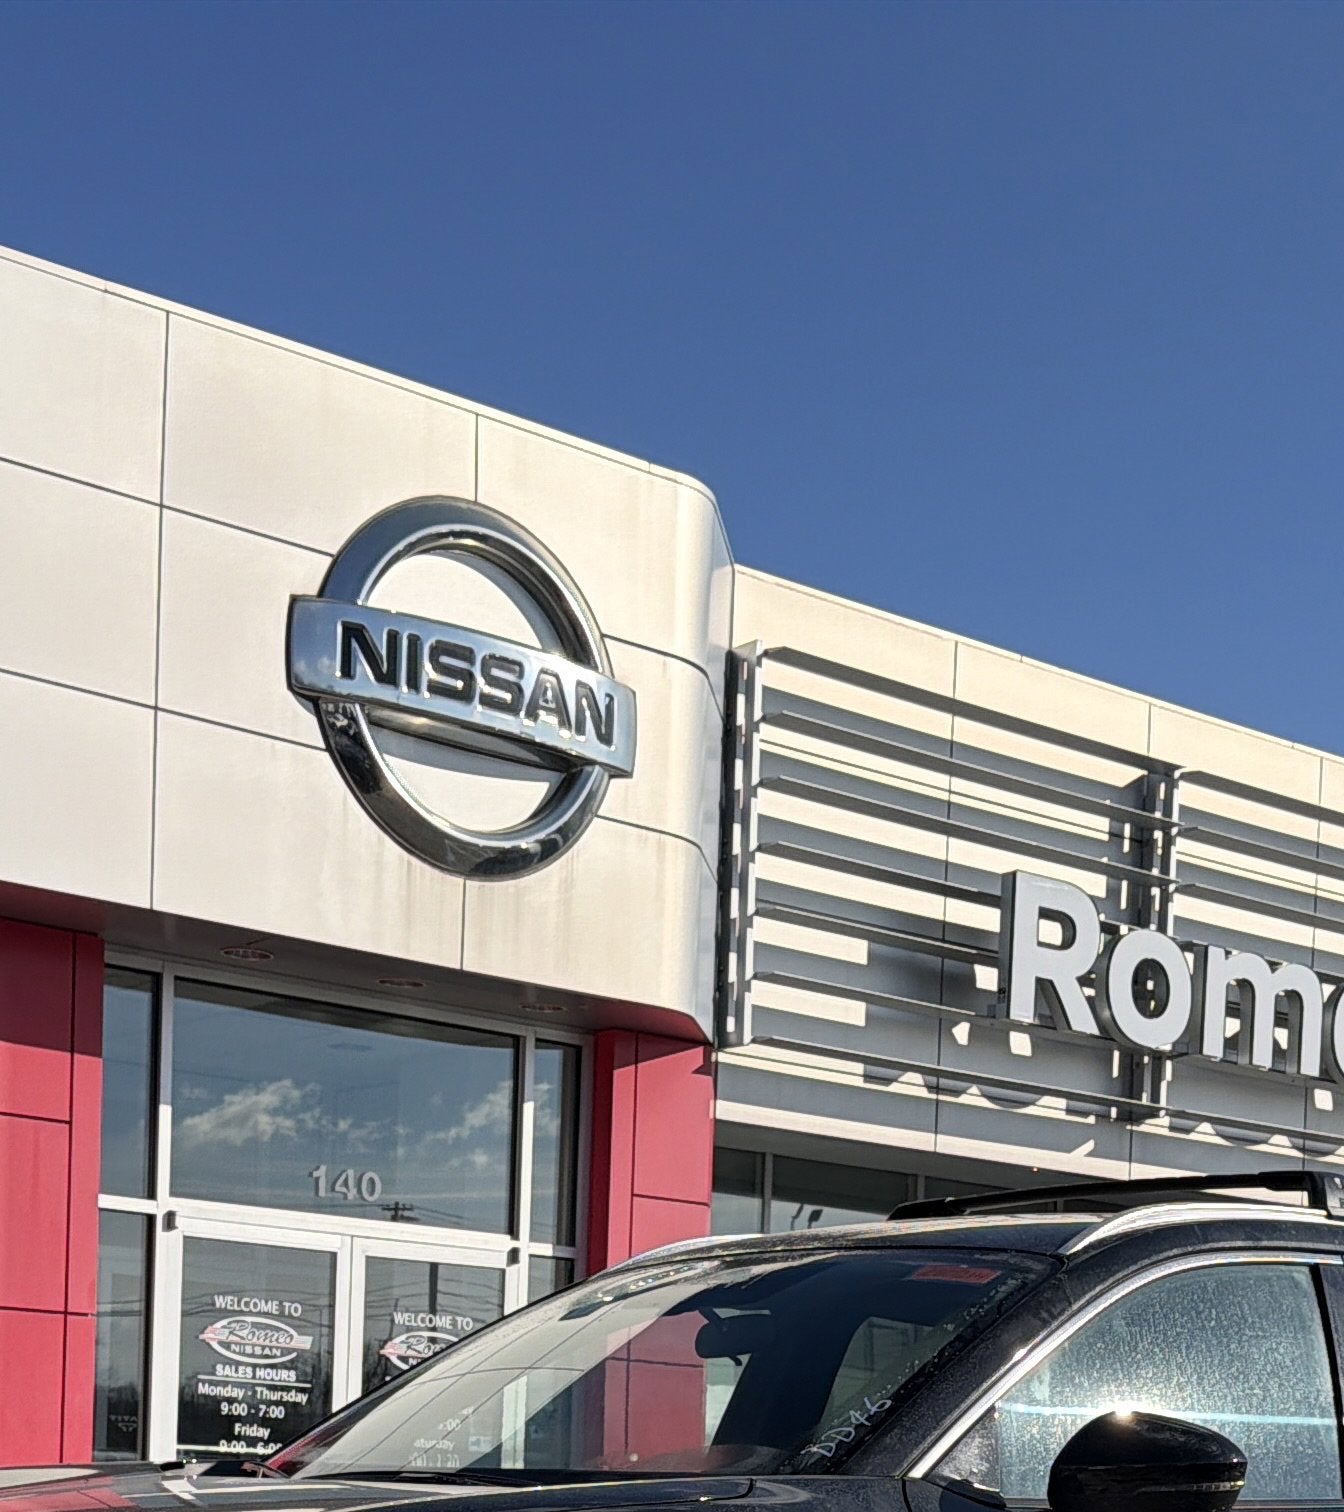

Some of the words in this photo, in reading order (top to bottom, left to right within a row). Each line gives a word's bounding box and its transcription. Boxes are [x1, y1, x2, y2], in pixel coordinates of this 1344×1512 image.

[337, 619, 617, 749] NISSAN
[311, 1164, 382, 1202] 140
[214, 1294, 280, 1315] WELCOME
[284, 1301, 303, 1317] TO
[393, 1311, 453, 1330] WELCOME
[455, 1316, 474, 1331] TO
[222, 1319, 295, 1345] Romeo
[230, 1343, 281, 1357] NISSAN
[216, 1363, 253, 1379] SALES
[255, 1368, 297, 1382] HOURS
[197, 1382, 246, 1400] Monday
[255, 1386, 309, 1406] Thursday
[220, 1402, 248, 1417] 9:00
[258, 1404, 285, 1419] 7:00
[234, 1422, 270, 1440] Friday
